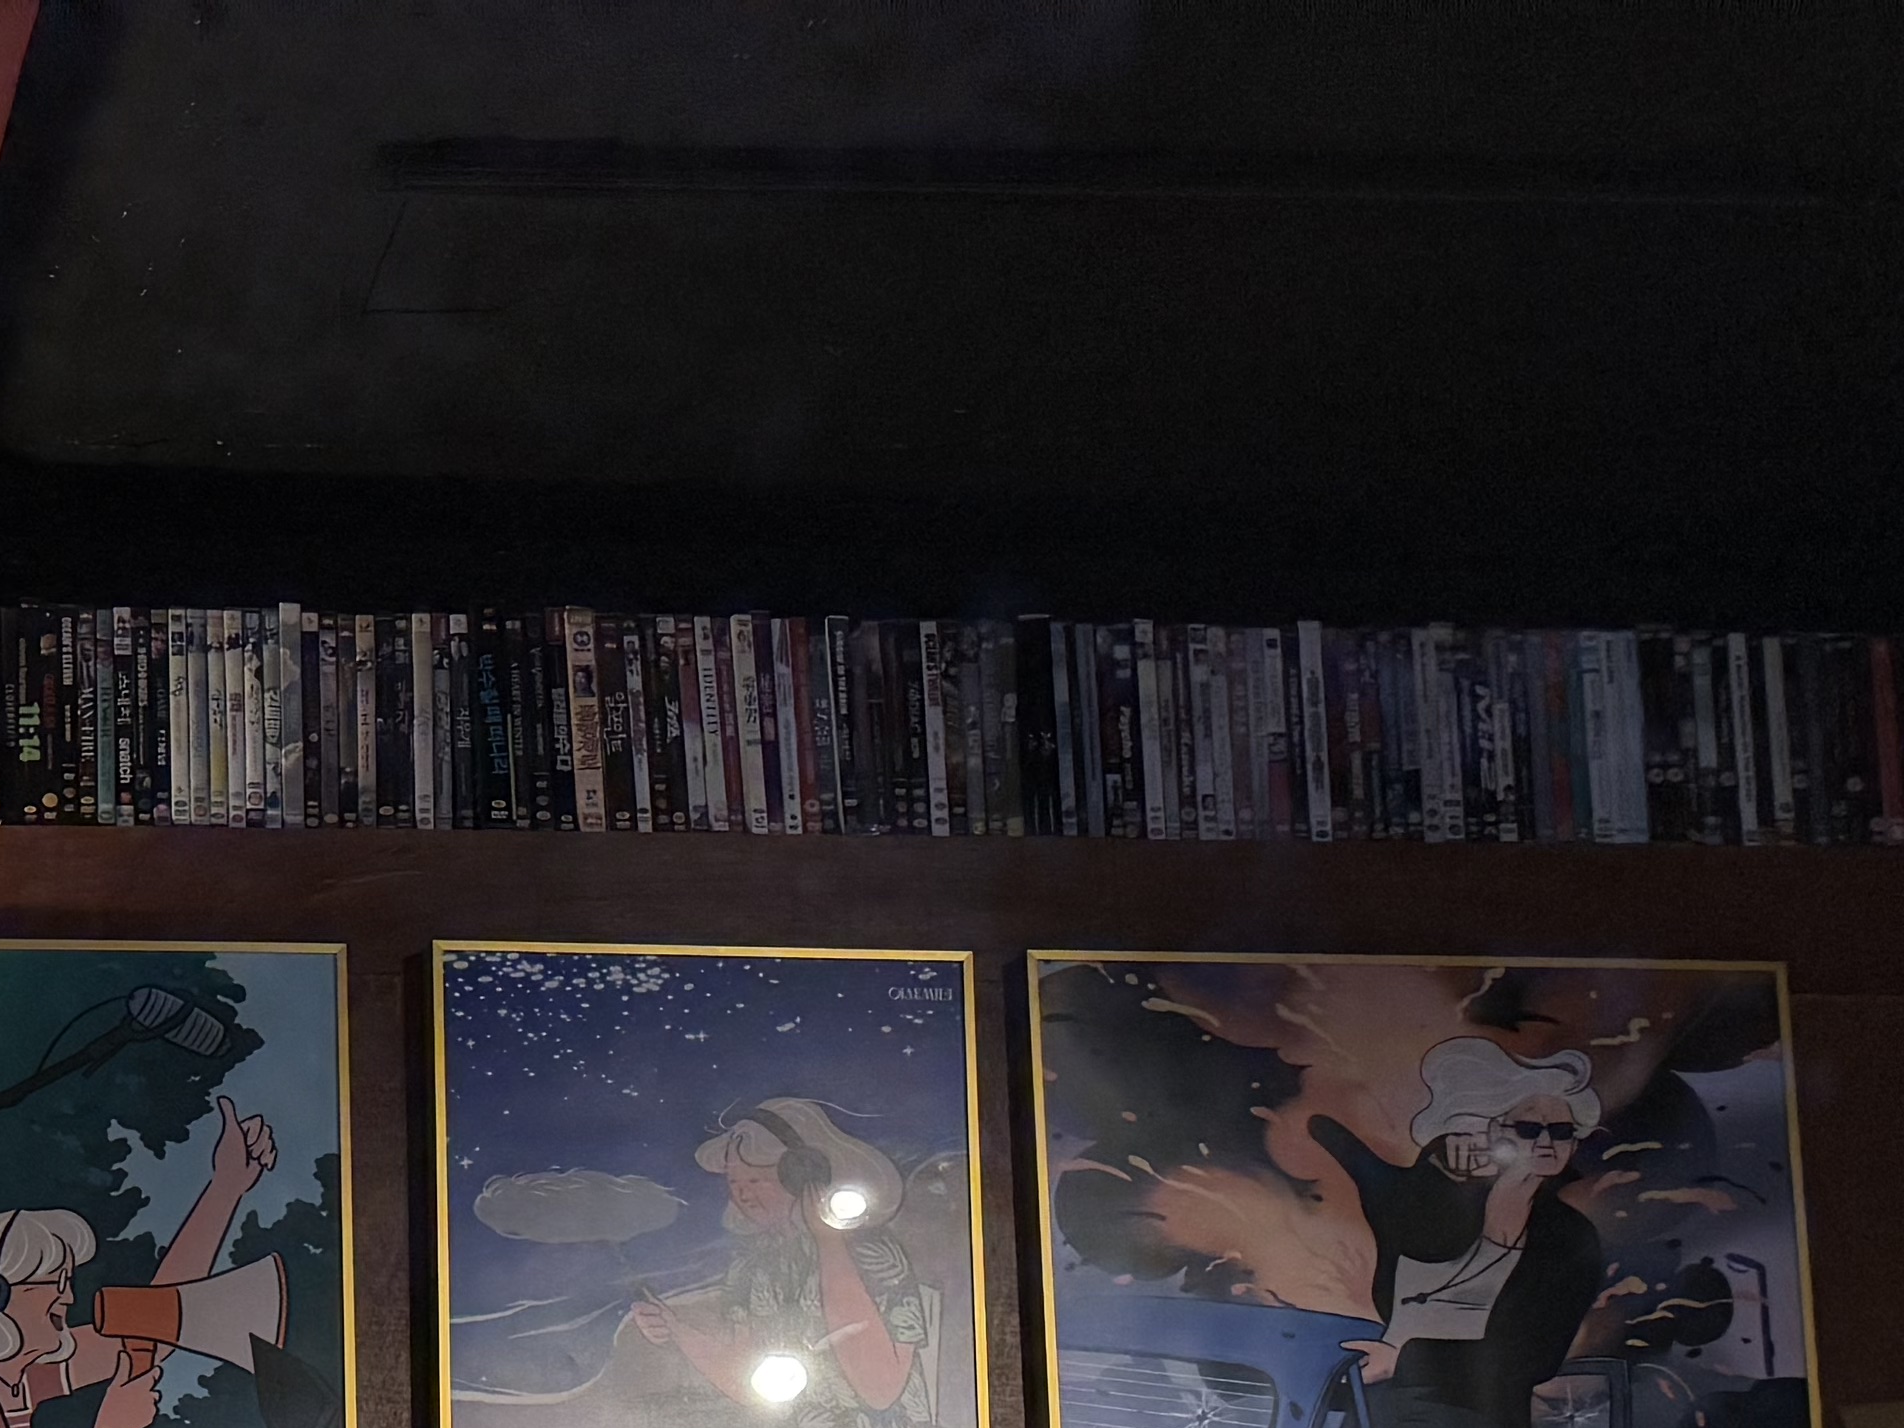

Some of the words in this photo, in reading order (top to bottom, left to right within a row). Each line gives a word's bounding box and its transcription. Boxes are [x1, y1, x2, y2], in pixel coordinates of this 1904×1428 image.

[18, 700, 41, 763] 11:14
[603, 690, 627, 753] 알포인트
[701, 667, 719, 737] IDENTITY
[118, 737, 134, 784] snatch
